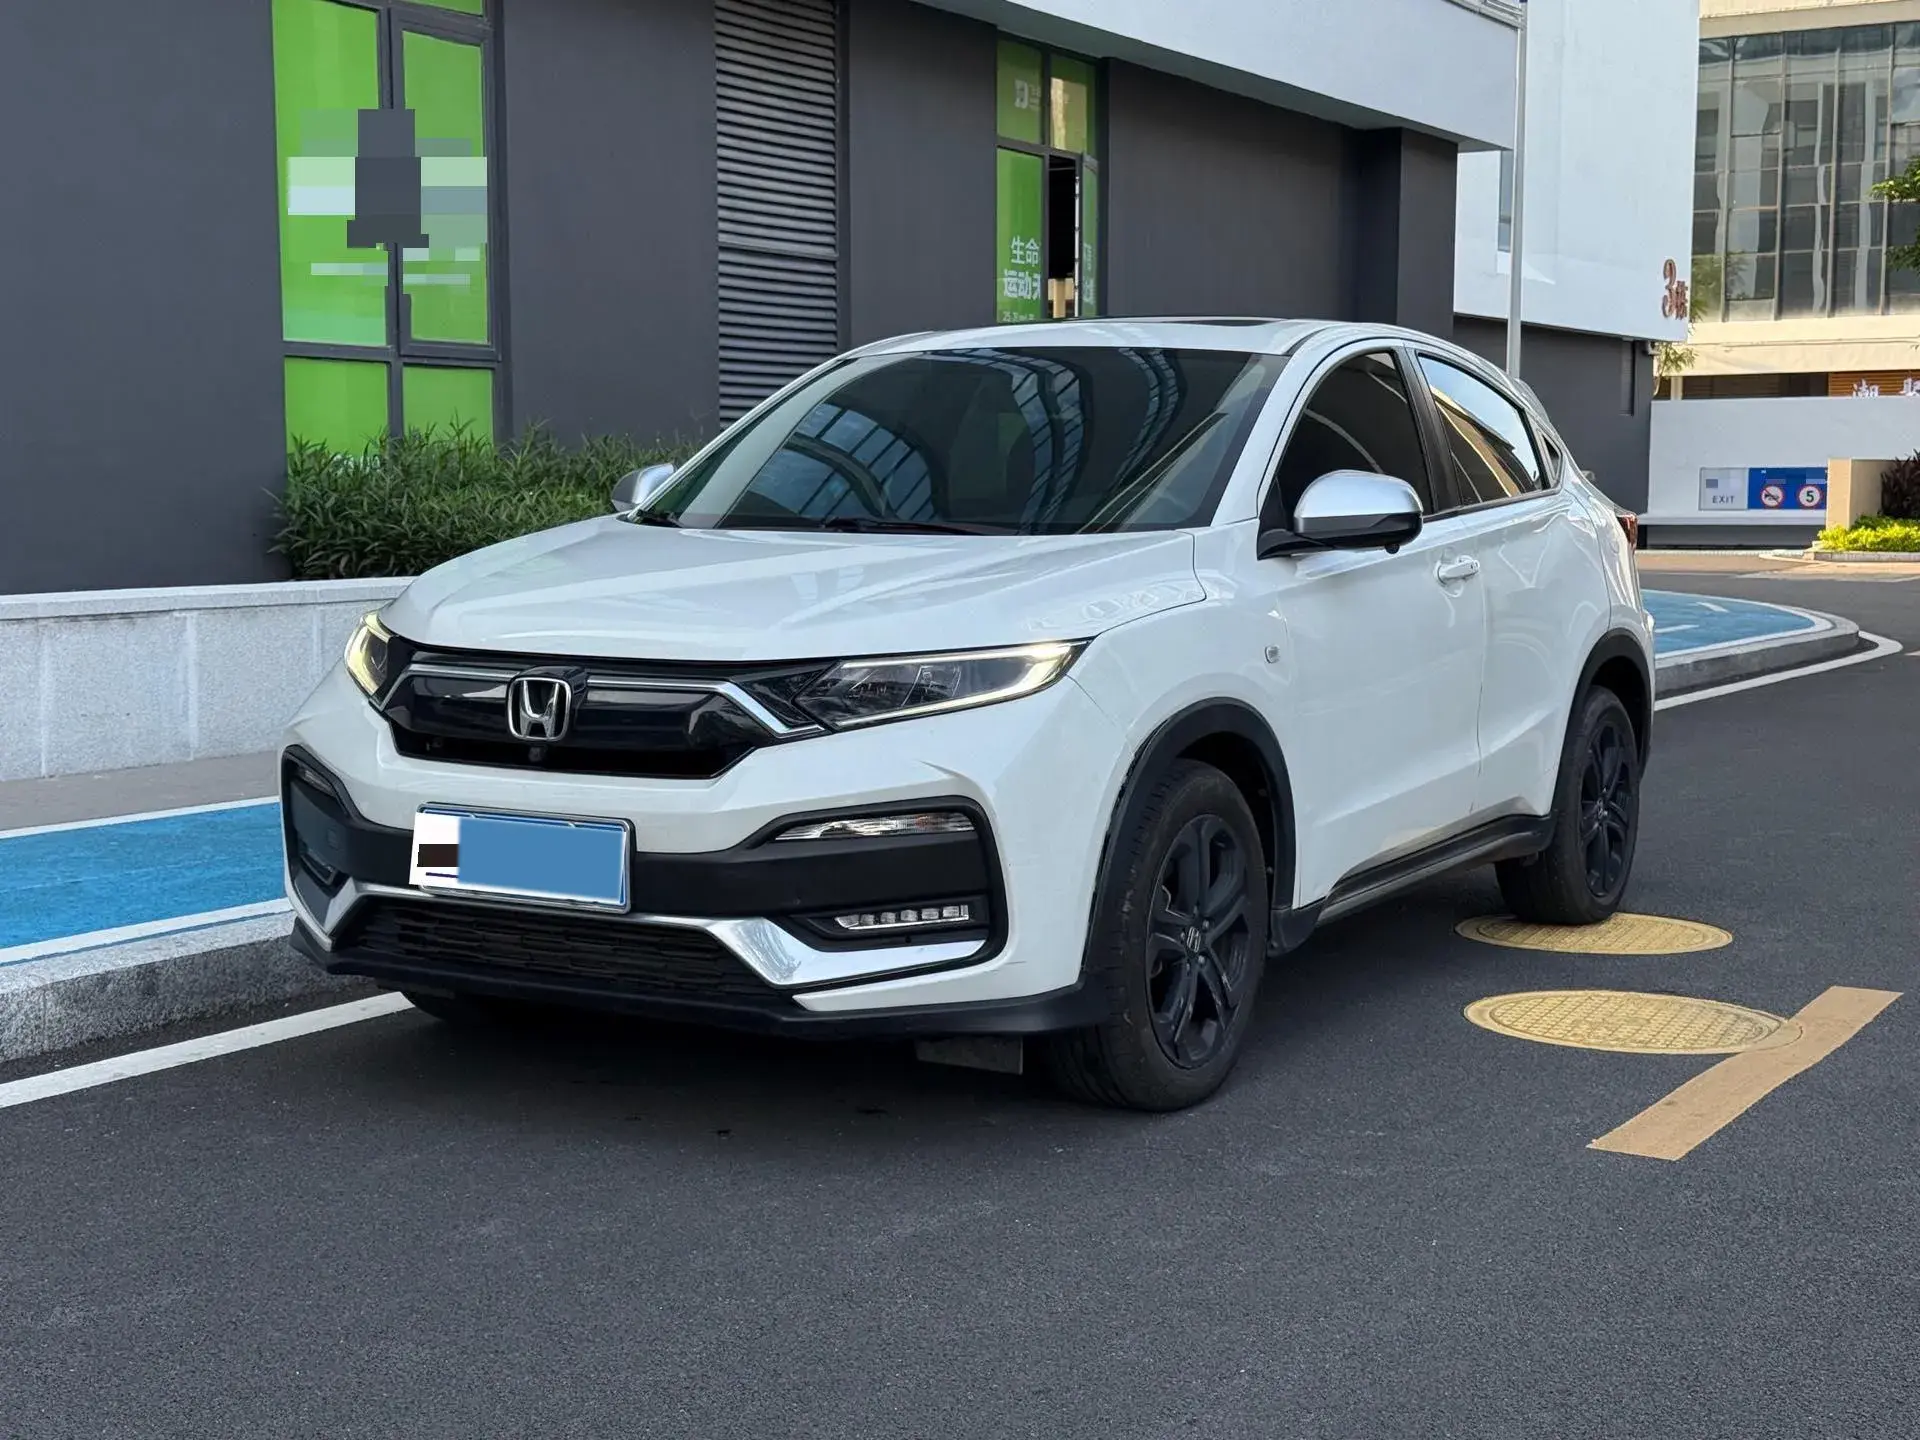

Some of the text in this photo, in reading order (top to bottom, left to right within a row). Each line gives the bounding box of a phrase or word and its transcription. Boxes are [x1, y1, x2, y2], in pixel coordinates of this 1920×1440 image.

[1011, 235, 1039, 267] 生命
[1711, 494, 1736, 504] EXIT
[1805, 490, 1815, 503] 5
